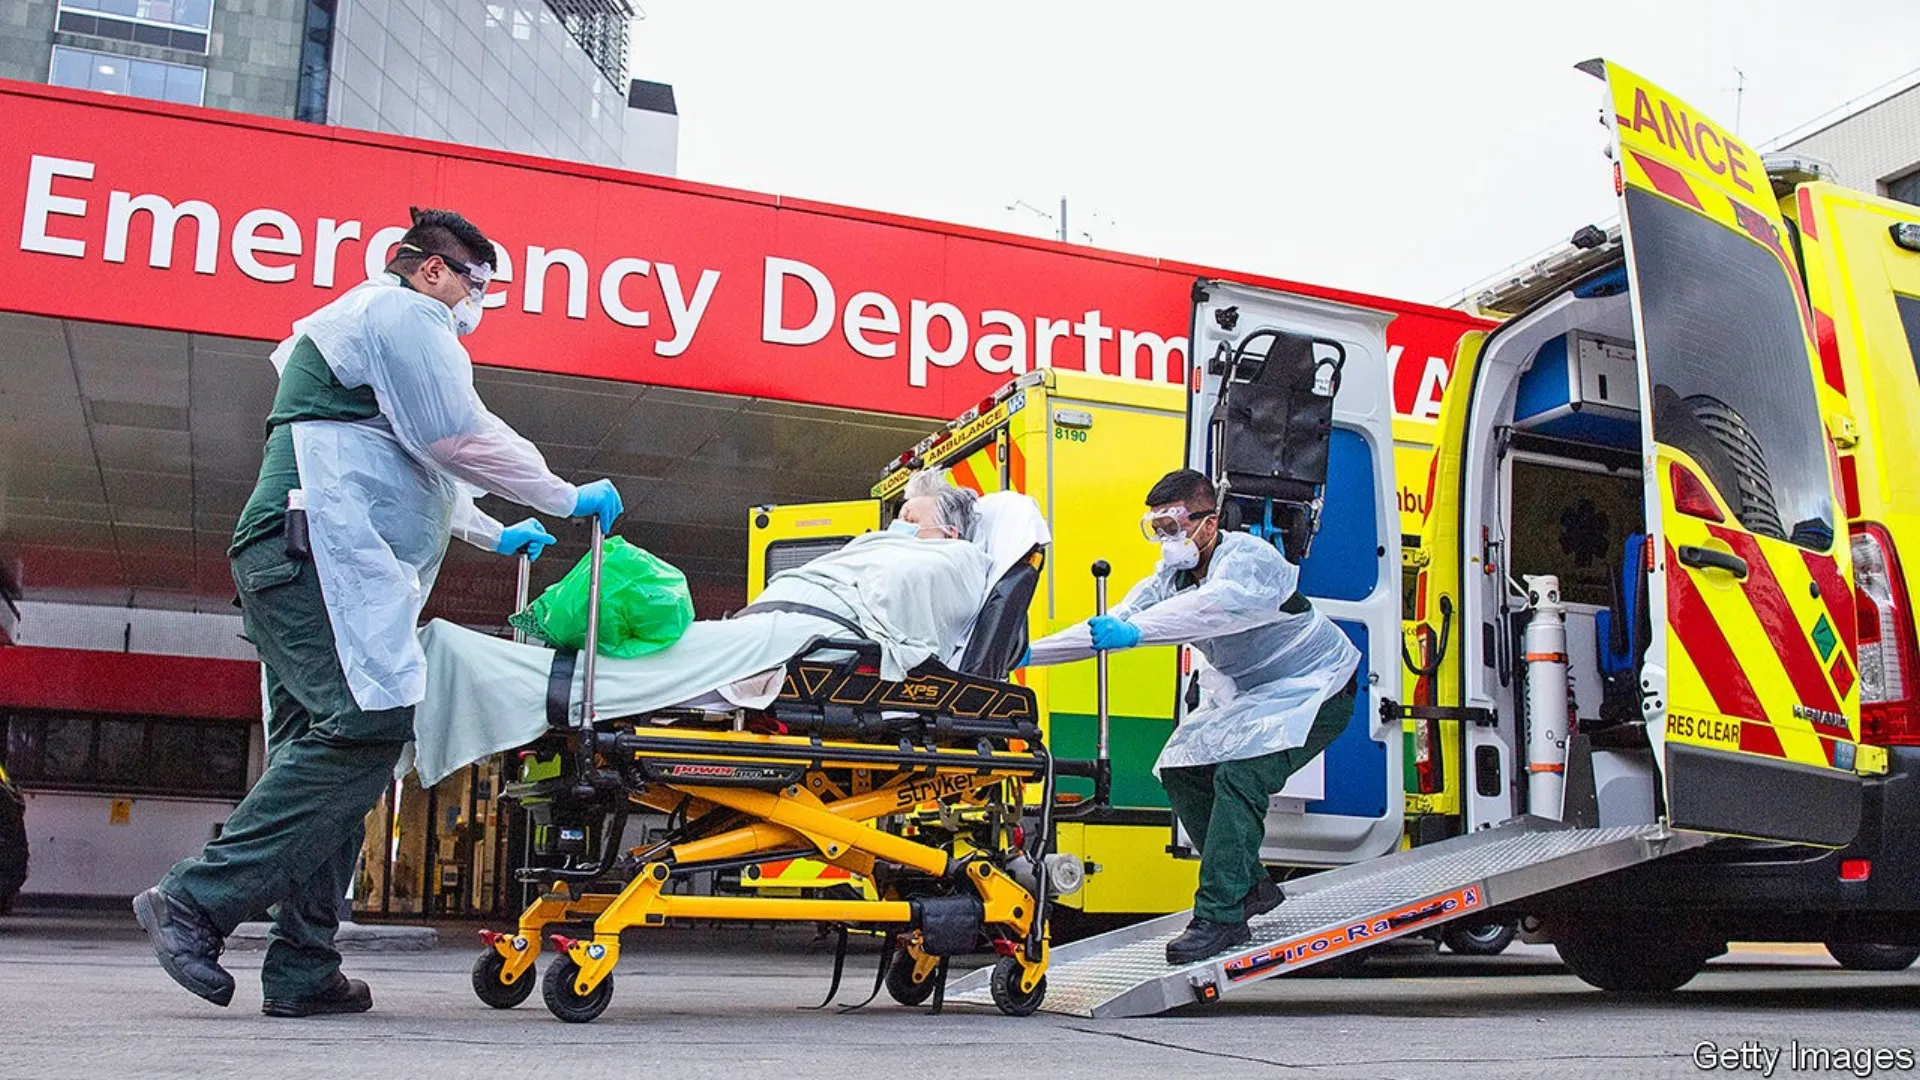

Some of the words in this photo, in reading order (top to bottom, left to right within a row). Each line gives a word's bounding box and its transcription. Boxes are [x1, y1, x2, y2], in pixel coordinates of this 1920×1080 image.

[928, 408, 1003, 462] AMBULANCE
[1054, 427, 1087, 443] 8190
[902, 684, 939, 698] XPS
[1667, 713, 1694, 737] RES
[1697, 718, 1740, 743] CLEAR
